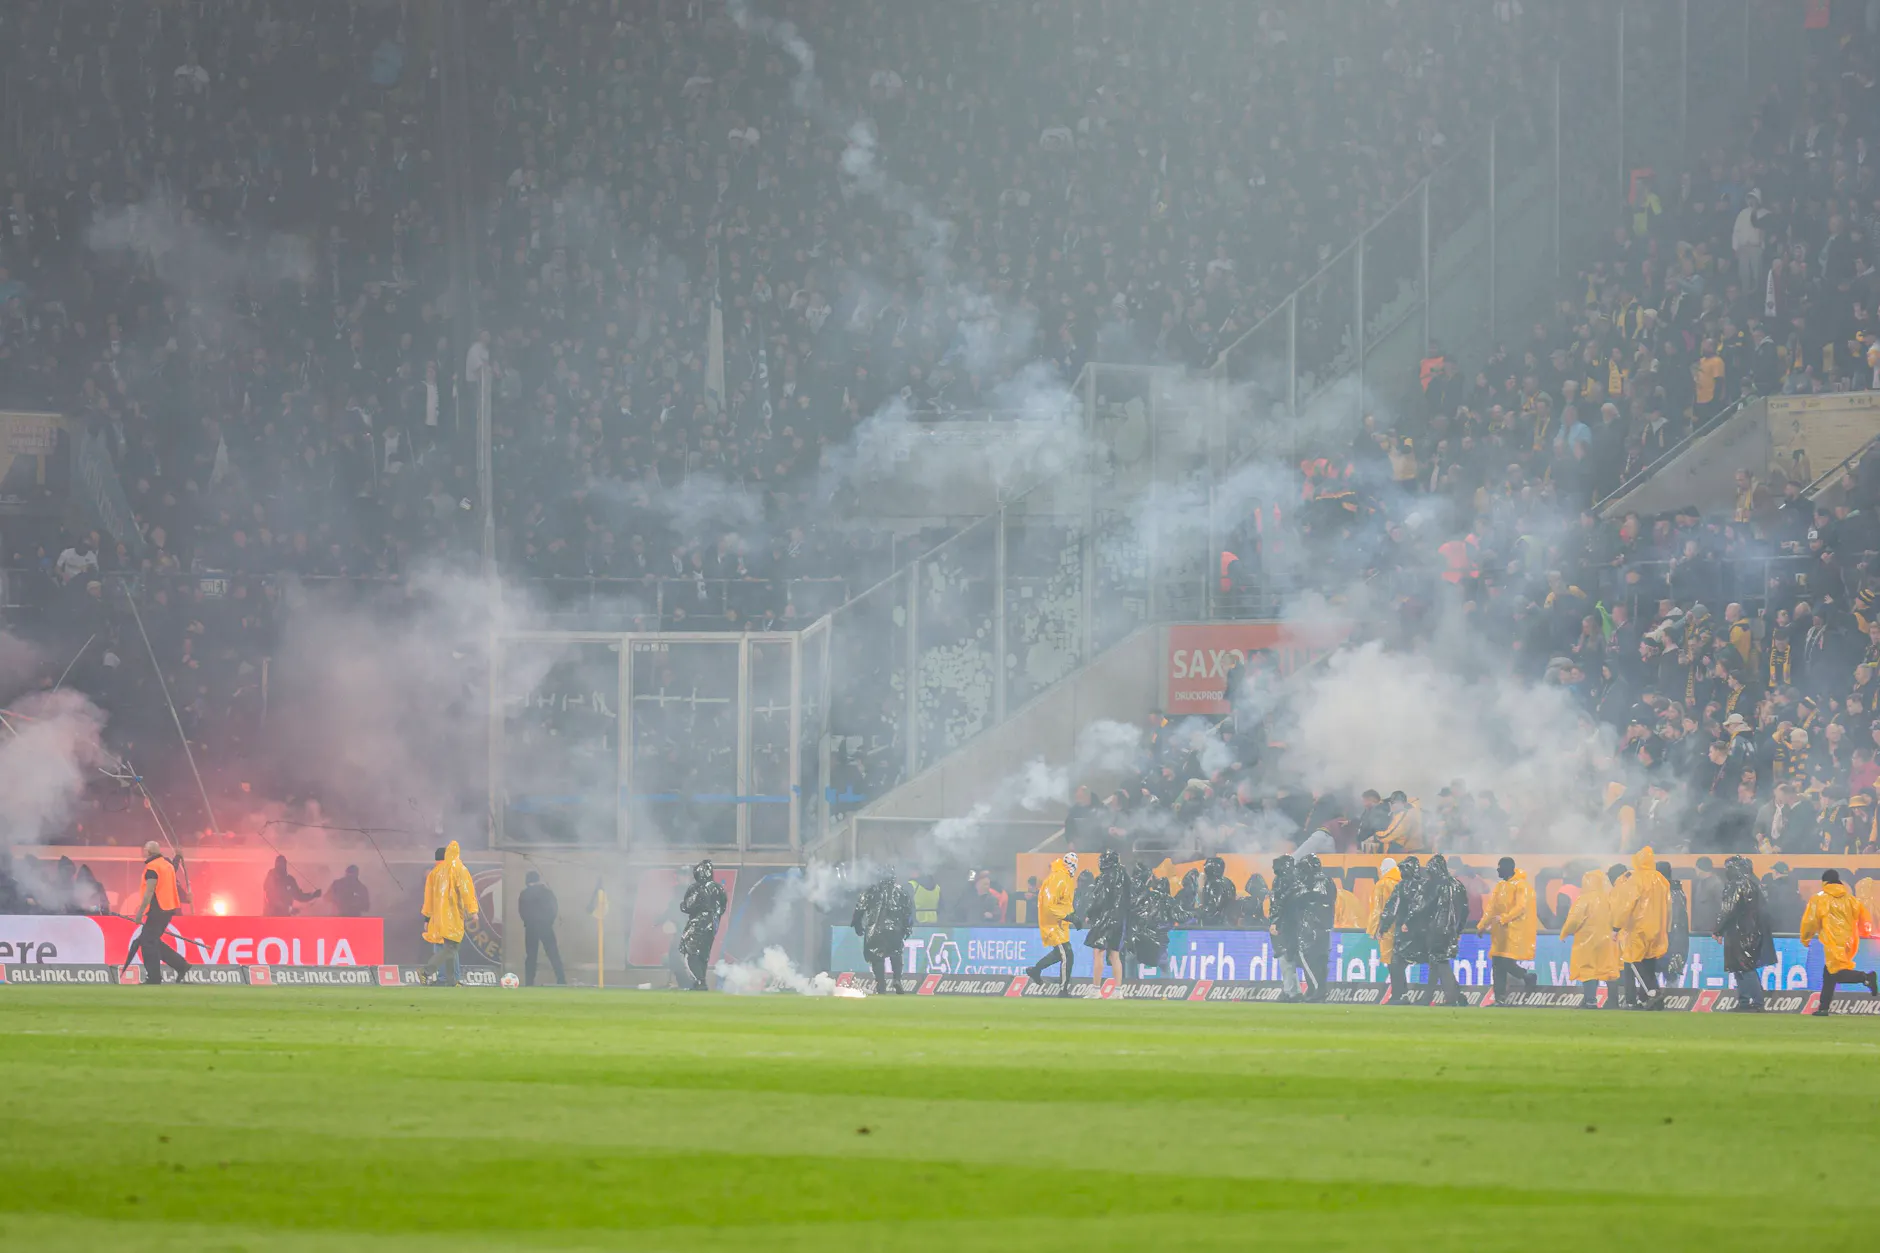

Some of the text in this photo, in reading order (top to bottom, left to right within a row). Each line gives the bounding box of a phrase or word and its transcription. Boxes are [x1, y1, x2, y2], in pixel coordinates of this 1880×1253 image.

[196, 937, 357, 965] VEOLIA
[967, 940, 1027, 960] ENERGIE
[12, 969, 110, 983] ALL-INKL.COM
[276, 970, 371, 984] ALL-INKL.COM
[938, 980, 1005, 994] ALL-INKL.COM
[1208, 985, 1283, 1000] ALL-INKL.COM
[1504, 991, 1584, 1006] ALL-INKL.COM
